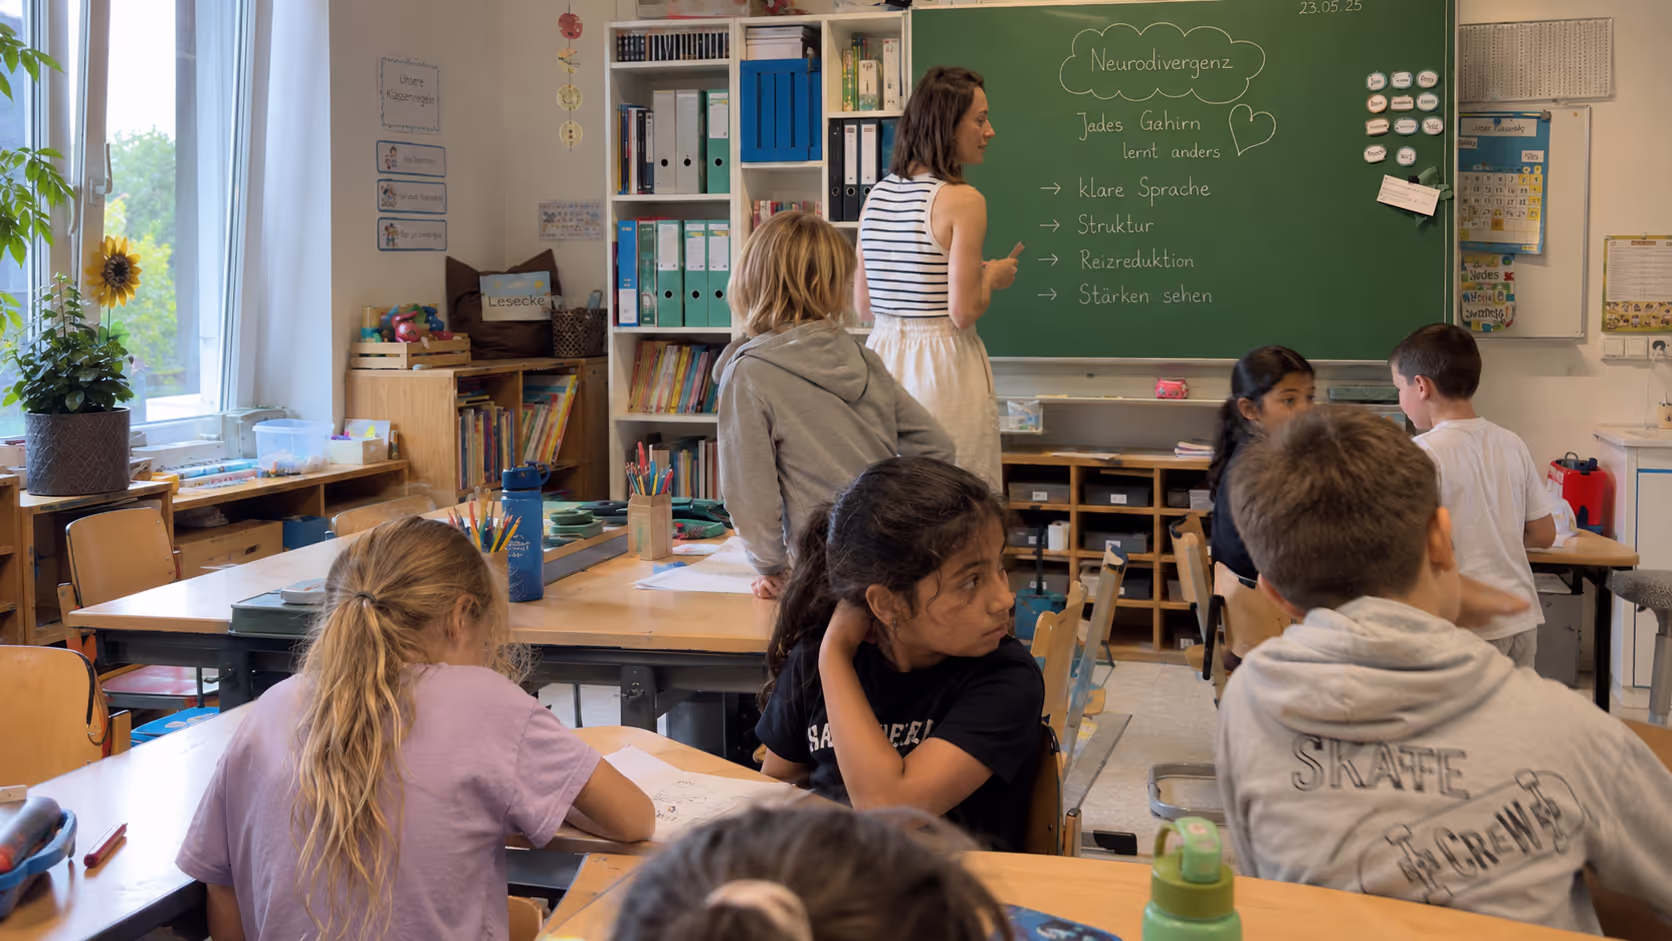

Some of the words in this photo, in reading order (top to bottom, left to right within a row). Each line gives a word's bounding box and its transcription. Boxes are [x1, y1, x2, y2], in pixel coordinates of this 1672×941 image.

[1298, 0, 1363, 14] 23.05.25
[1091, 48, 1234, 79] Neurodivergenz
[1077, 111, 1124, 141] Jades
[1140, 110, 1201, 131] Gahirn
[1123, 142, 1159, 159] lernt
[1171, 142, 1221, 159] anders
[1078, 177, 1125, 199] klare
[1138, 176, 1212, 206] Sprache
[1078, 213, 1155, 235] Struktur
[1080, 249, 1195, 271] Reizreduktion
[488, 295, 545, 307] Lesecke
[1078, 283, 1150, 305] Stärken
[1162, 284, 1213, 304] sehen
[1433, 799, 1543, 879] CREW
